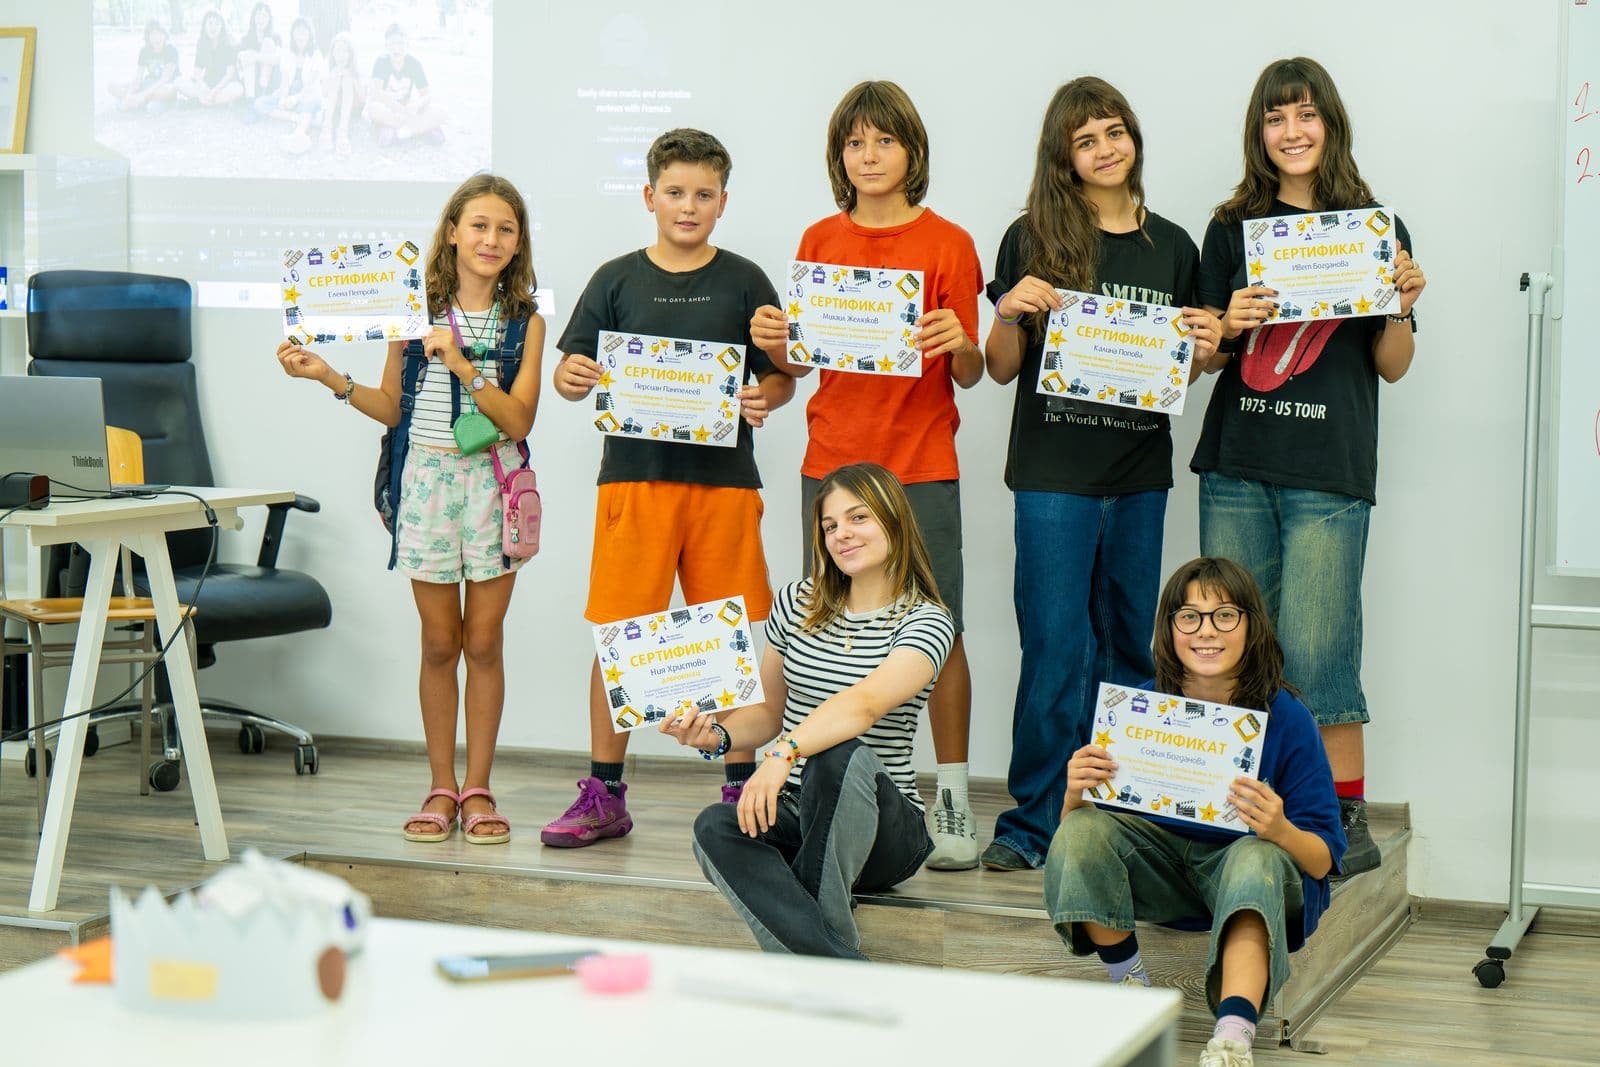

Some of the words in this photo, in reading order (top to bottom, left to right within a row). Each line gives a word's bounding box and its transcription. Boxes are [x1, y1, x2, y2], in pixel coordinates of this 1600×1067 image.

[1273, 242, 1365, 261] СЕРТИФИКАТ
[1292, 261, 1312, 271] Ивет
[1313, 260, 1349, 272] Богданова
[308, 271, 395, 288] СЕРТИФИКАТ
[328, 289, 347, 298] Елена
[349, 287, 379, 298] Петрова
[1101, 282, 1173, 307] SMITHS
[810, 295, 894, 312] СЕРТИФИКАТ
[1076, 325, 1165, 349] СЕРТИФИКАТ
[1094, 344, 1117, 355] Калина
[1119, 348, 1143, 359] Попова
[624, 365, 714, 384] СЕРТИФИКАТ
[1240, 397, 1266, 413] 1975
[1275, 401, 1292, 416] US
[1294, 402, 1327, 419] TOUR
[1043, 413, 1062, 422] The
[1065, 413, 1098, 425] World
[1102, 416, 1131, 429] Won't
[72, 456, 104, 468] ThinkBook
[629, 638, 721, 668] СЕРТИФИКАТ
[650, 666, 666, 677] Ния
[668, 658, 707, 674] Христова
[1125, 725, 1227, 756] СЕРТИФИКАТ
[1140, 746, 1165, 758] София
[1166, 750, 1206, 767] Богданова
